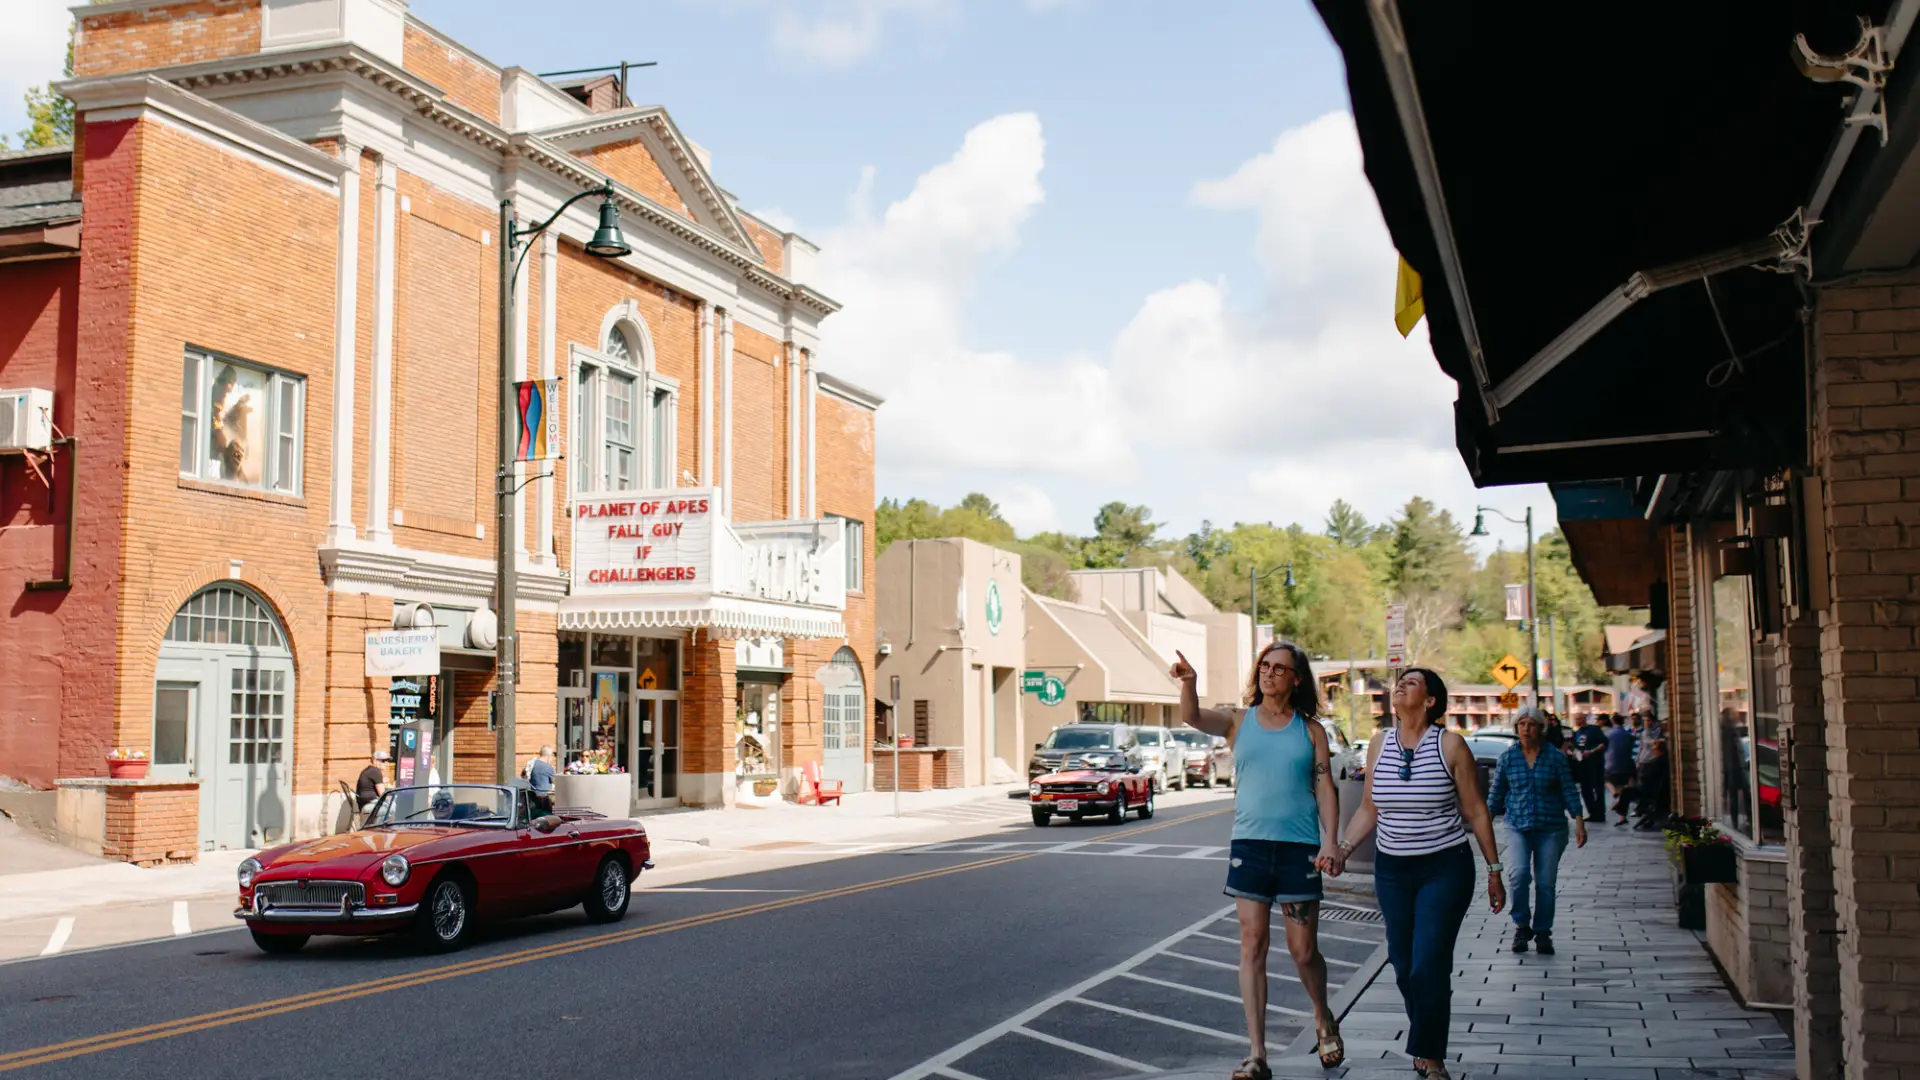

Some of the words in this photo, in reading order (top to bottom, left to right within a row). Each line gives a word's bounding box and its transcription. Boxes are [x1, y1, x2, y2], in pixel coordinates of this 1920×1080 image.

[547, 383, 557, 453] WELCOME
[578, 503, 636, 518] PLANET
[640, 501, 660, 515] OF
[666, 499, 708, 514] APES
[608, 524, 643, 539] FALL
[652, 522, 683, 537] GUY
[636, 545, 652, 560] IF
[588, 566, 696, 583] CHALLENGERS
[380, 646, 423, 656] BAKERY
[391, 694, 422, 707] AKERY
[1502, 694, 1518, 704] 20
[405, 732, 415, 748] P
